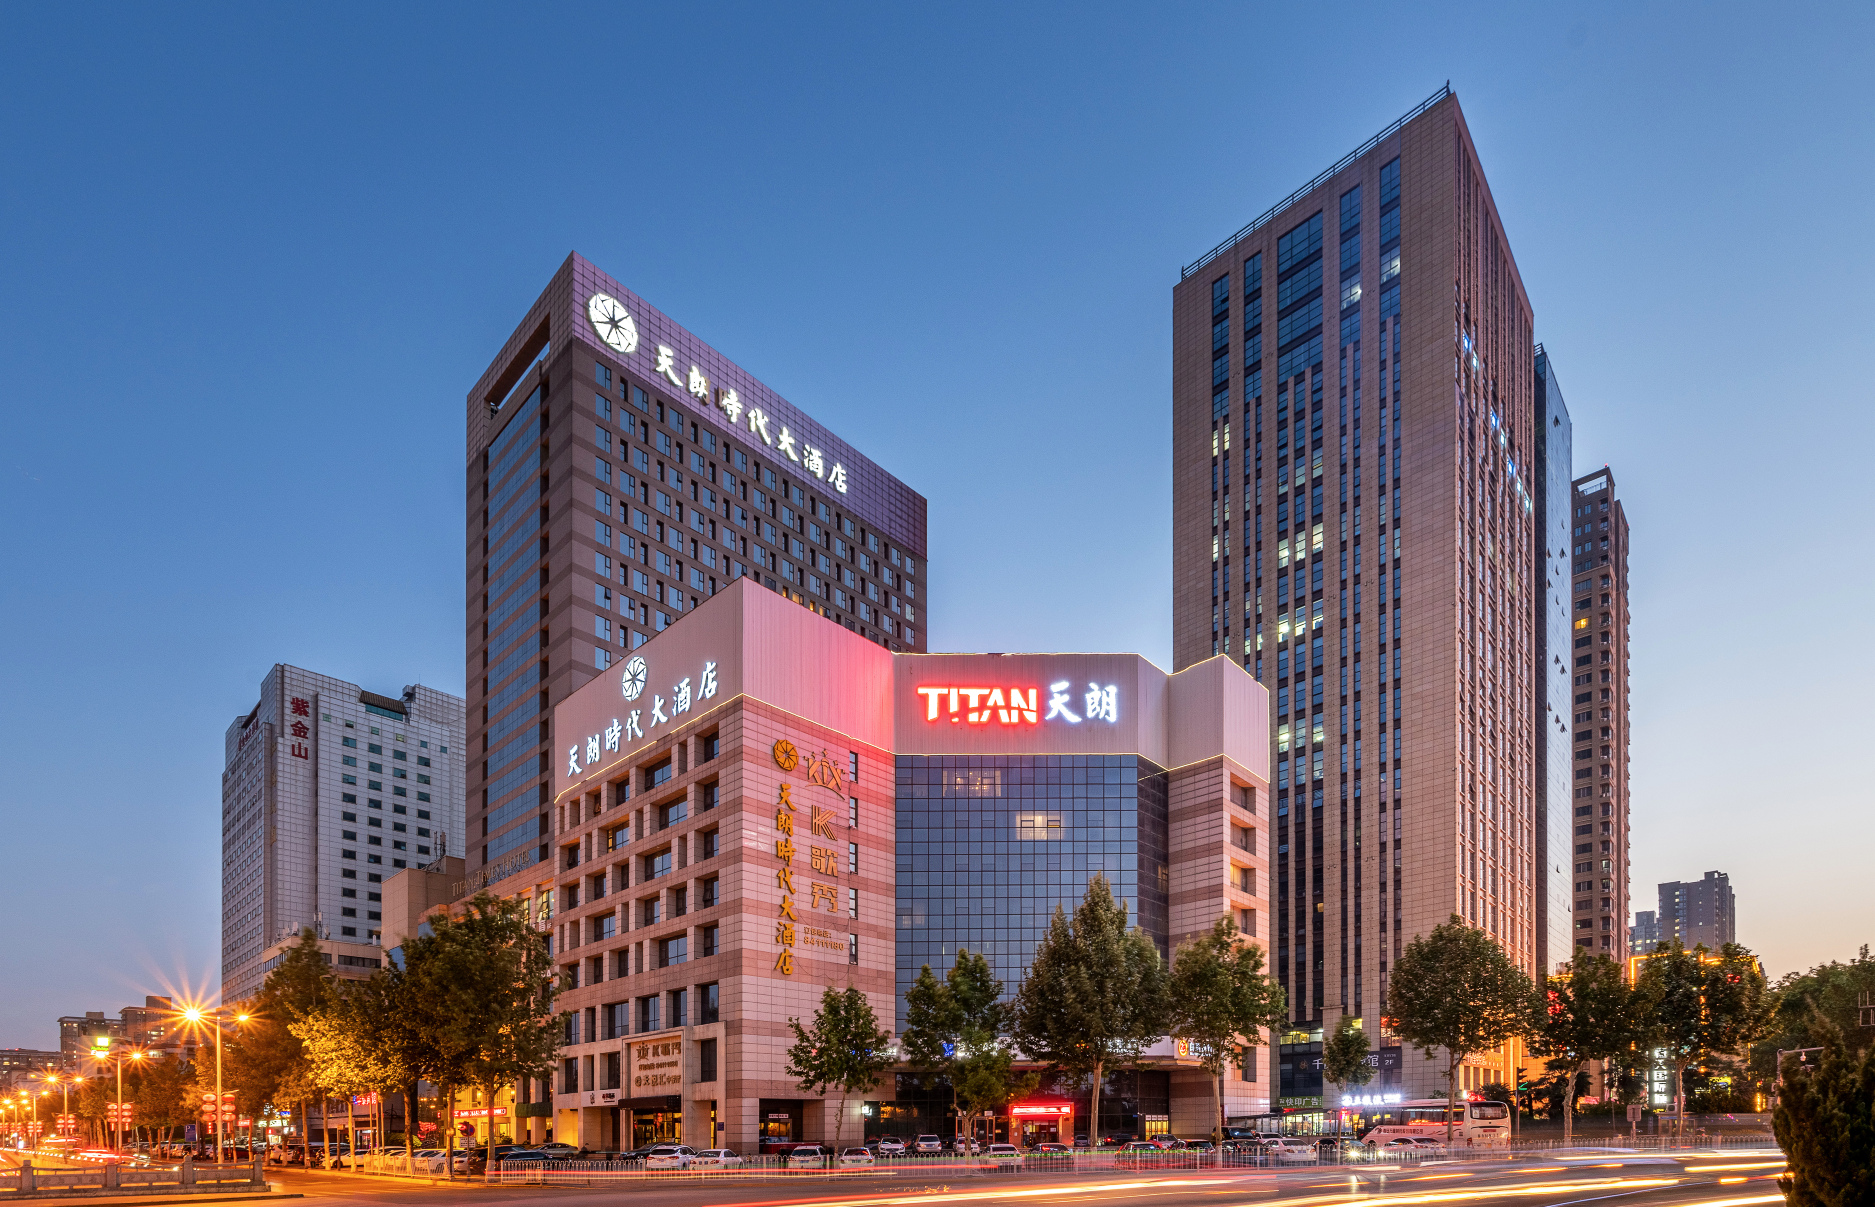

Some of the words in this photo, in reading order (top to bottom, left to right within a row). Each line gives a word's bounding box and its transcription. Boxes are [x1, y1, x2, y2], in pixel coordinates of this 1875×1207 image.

[290, 696, 310, 761] 紫金山
[567, 661, 719, 778] 天朗時代大酒店
[917, 686, 1038, 724] TITAN
[1045, 680, 1118, 724] 天朗
[774, 783, 798, 976] 天朗時代大酒店
[1286, 1096, 1319, 1107] 快印广告
